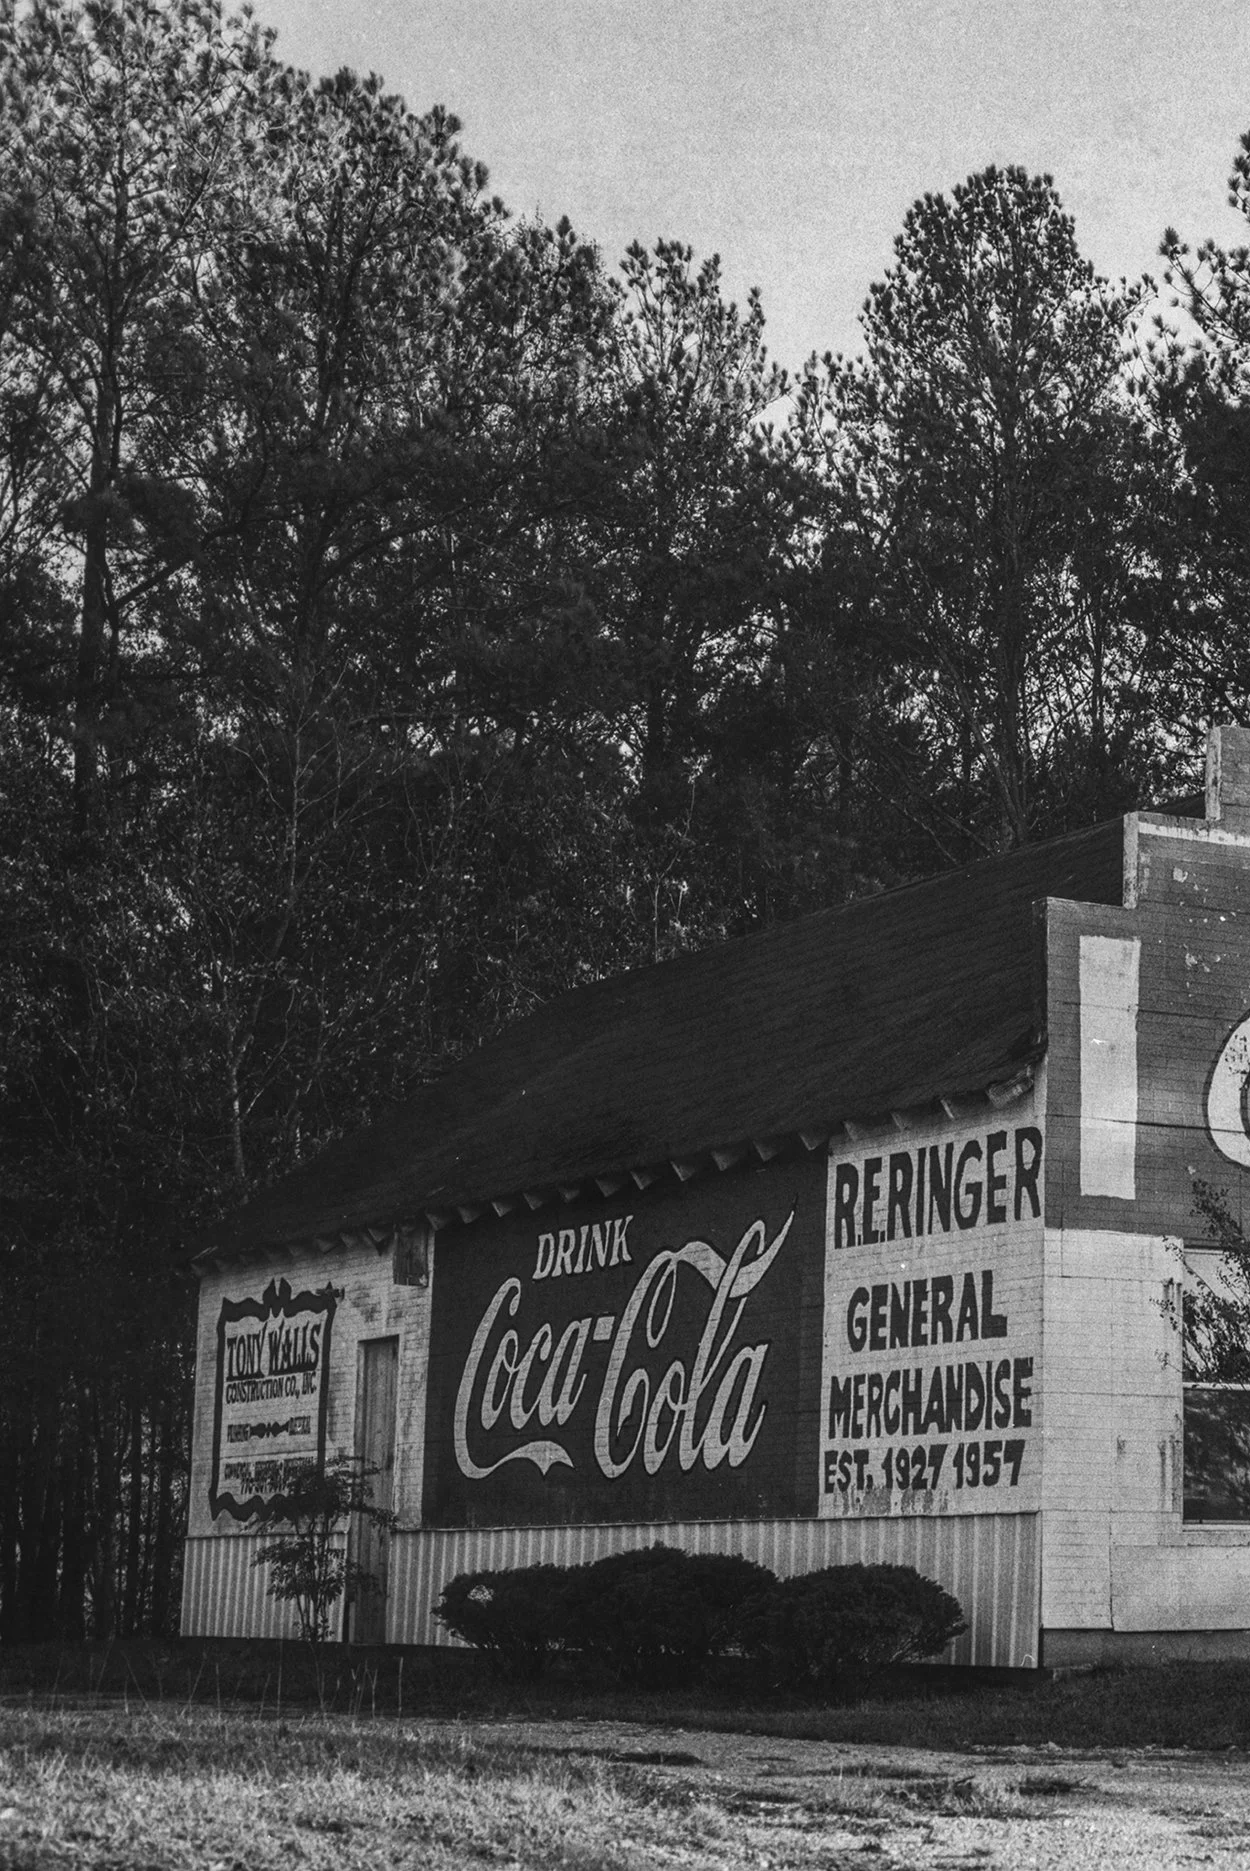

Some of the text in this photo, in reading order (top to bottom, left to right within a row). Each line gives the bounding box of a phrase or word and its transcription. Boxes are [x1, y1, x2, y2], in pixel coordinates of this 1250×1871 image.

[532, 1215, 634, 1280] DRINK
[847, 1269, 1008, 1352] GENERAL
[226, 1317, 322, 1383] TONY WALLS
[454, 1210, 795, 1479] Coca-Cola
[225, 1376, 285, 1405] CONSTRUCTION
[828, 1356, 1034, 1440] MERCHANDISE
[824, 1439, 1026, 1494] EST. 1927 1957
